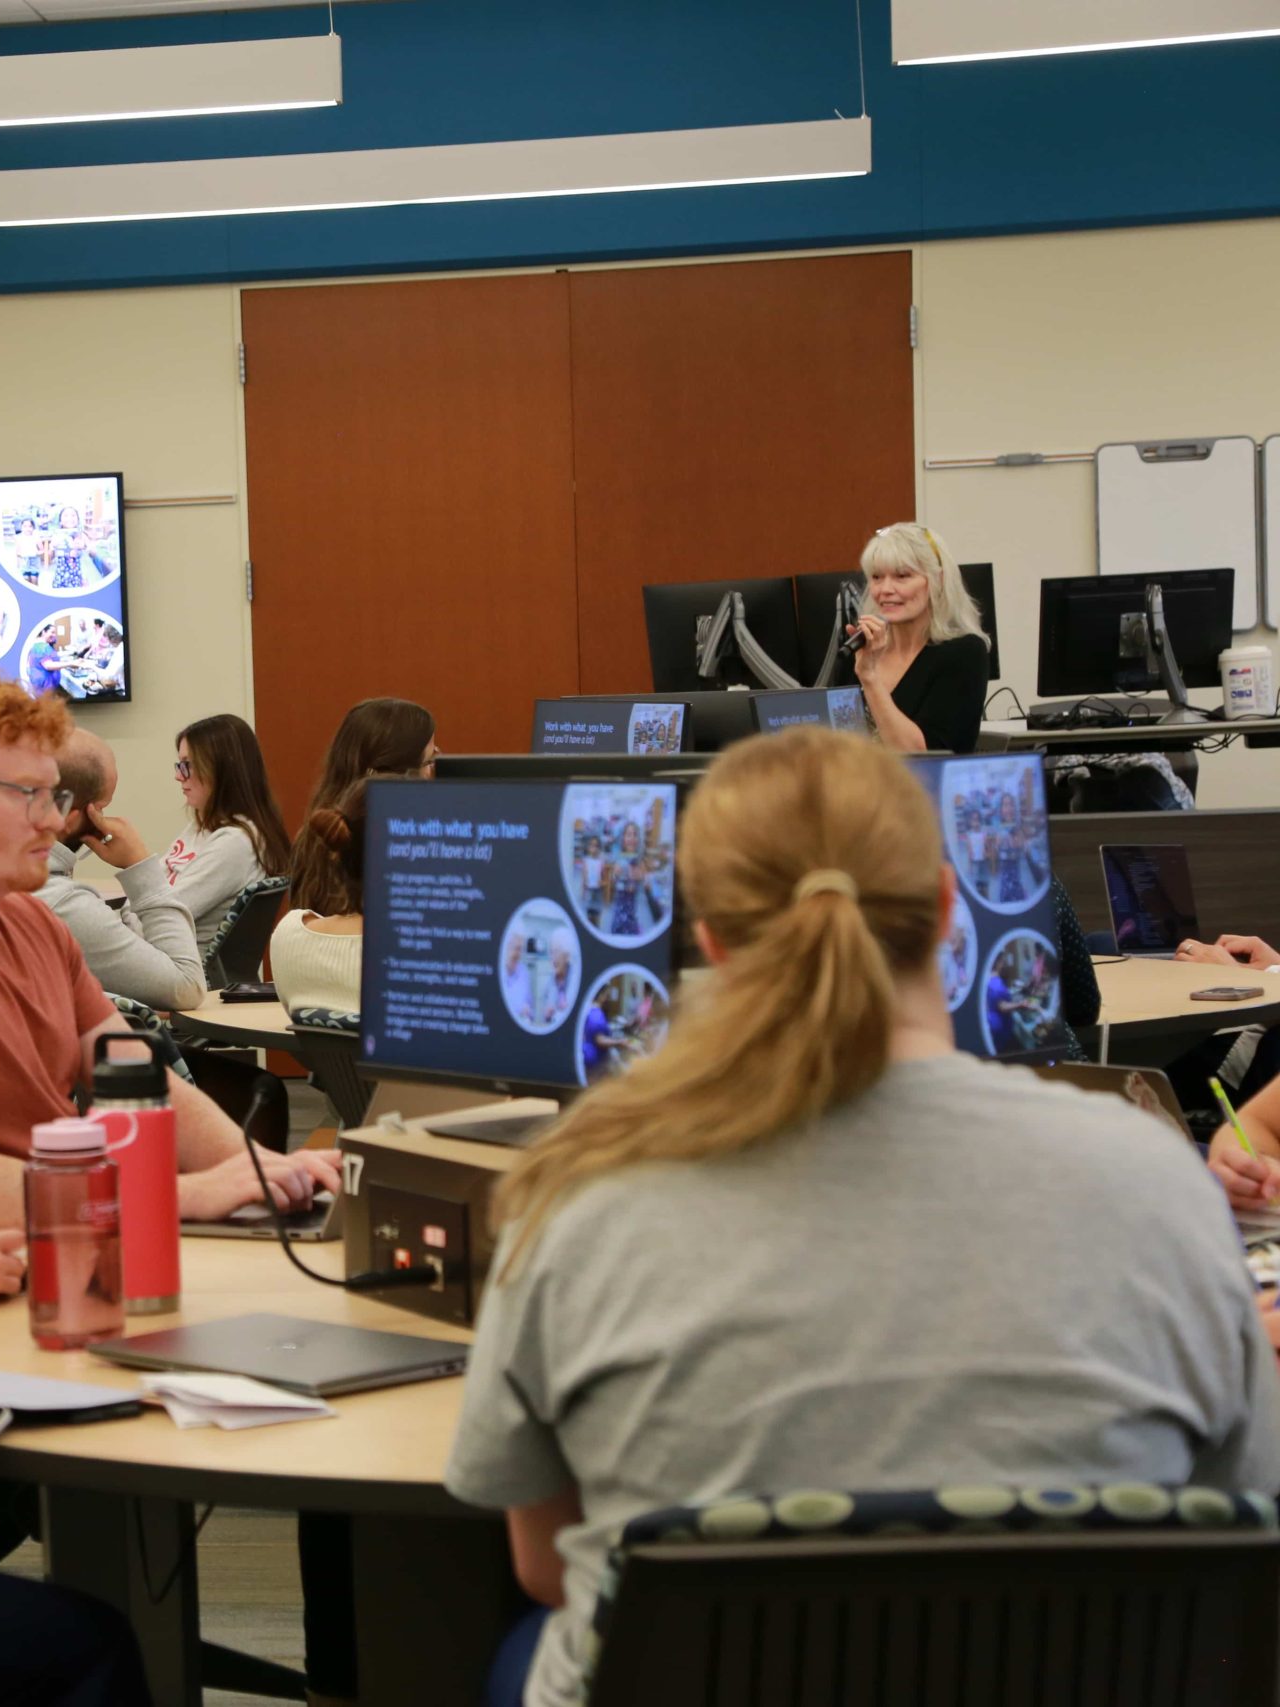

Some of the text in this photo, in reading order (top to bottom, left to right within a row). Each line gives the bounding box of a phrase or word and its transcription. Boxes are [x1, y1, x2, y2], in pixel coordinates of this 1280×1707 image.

[544, 721, 613, 734] Work with what you have
[387, 818, 529, 841] Work with what you have
[388, 842, 411, 859] (and
[440, 843, 464, 859] have
[343, 1153, 364, 1196] 17
